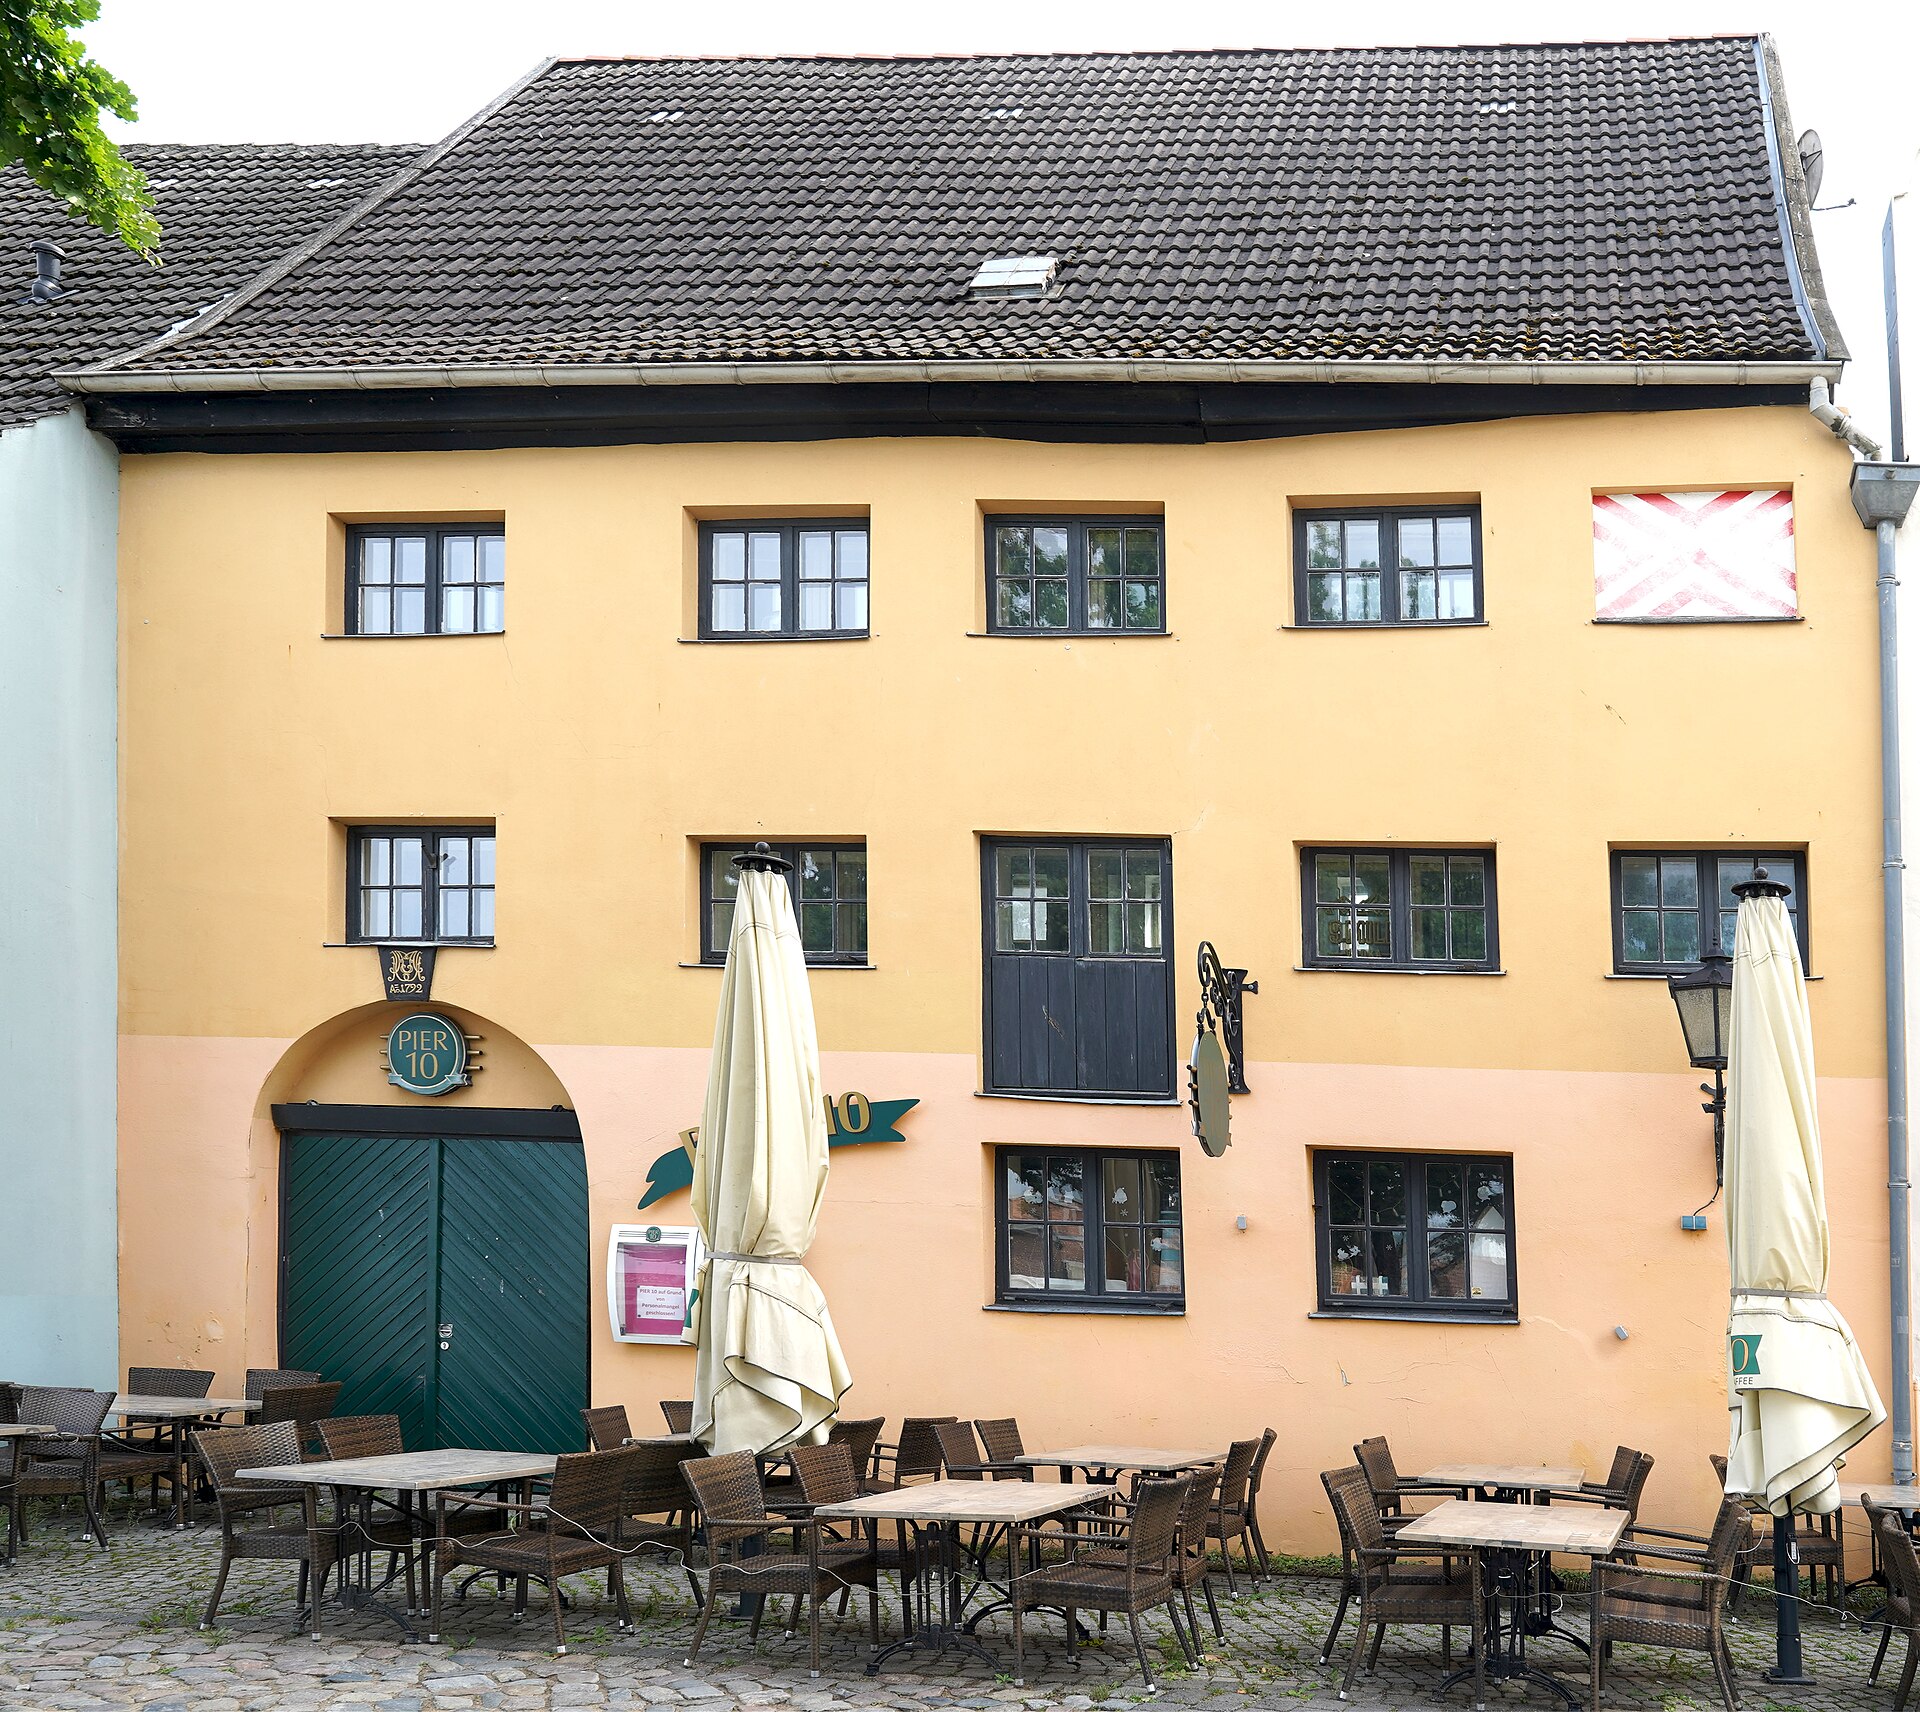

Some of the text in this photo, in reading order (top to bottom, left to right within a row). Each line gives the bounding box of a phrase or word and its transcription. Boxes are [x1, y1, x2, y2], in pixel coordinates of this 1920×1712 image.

[398, 1030, 448, 1051] PIER
[405, 1052, 439, 1079] 10
[1731, 1338, 1749, 1373] 0
[1734, 1376, 1753, 1385] FFEE
